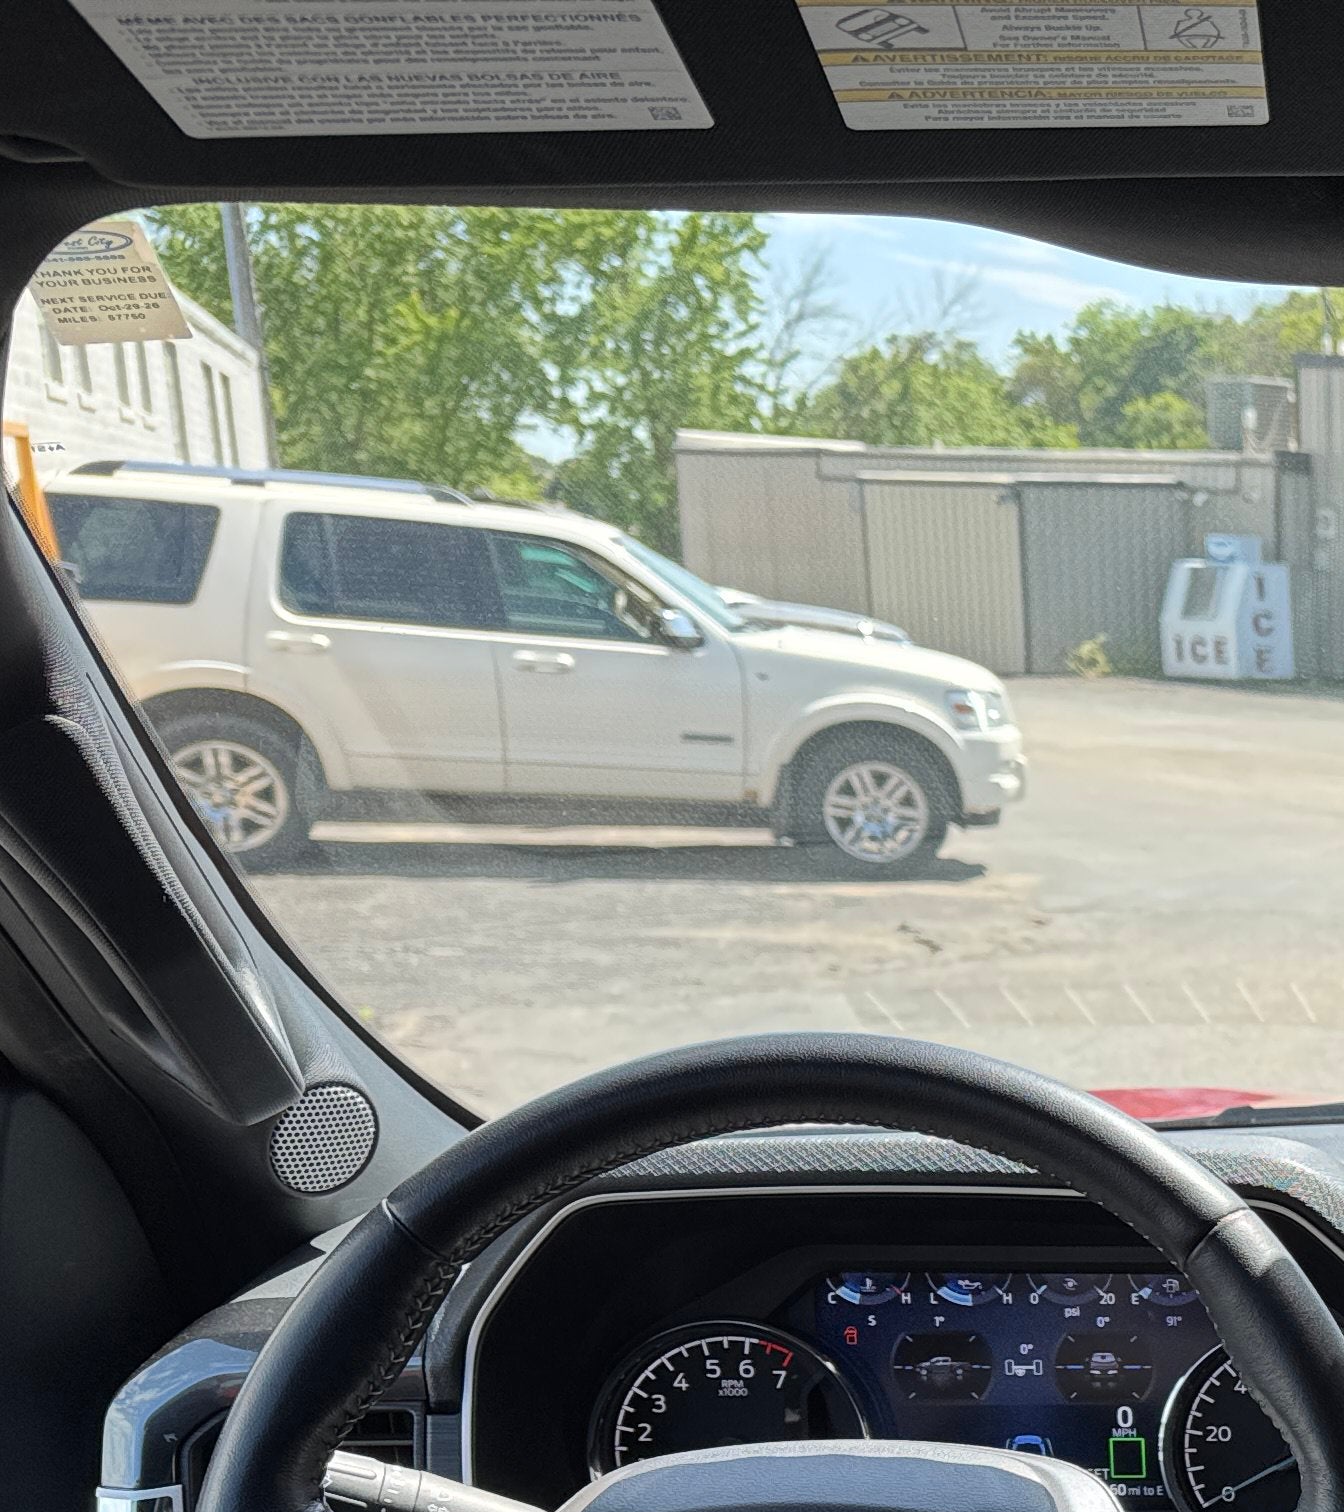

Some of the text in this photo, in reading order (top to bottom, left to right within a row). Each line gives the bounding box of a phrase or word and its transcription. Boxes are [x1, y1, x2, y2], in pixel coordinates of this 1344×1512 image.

[88, 236, 113, 249] City
[86, 267, 118, 275] YOU
[121, 265, 153, 274] FOR
[36, 275, 157, 288] YOUR BUSINESS
[41, 296, 78, 305] NEXT
[78, 293, 137, 304] SERVICE
[1252, 574, 1275, 674] ICE
[1172, 634, 1229, 665] ICE
[901, 1293, 911, 1304] H
[1098, 1293, 1116, 1304] 20
[1131, 1293, 1140, 1304] E
[1064, 1306, 1080, 1318] psi
[705, 1360, 721, 1378] 5
[738, 1359, 755, 1378] 6
[673, 1372, 690, 1391] 4
[721, 1379, 744, 1388] RPM
[772, 1370, 788, 1389] 7
[717, 1387, 748, 1397] x1000
[651, 1394, 668, 1413] 3
[1116, 1406, 1133, 1427] 0
[637, 1423, 653, 1442] 2
[1112, 1428, 1137, 1438] MPH
[1205, 1425, 1232, 1442] 20
[1128, 1485, 1141, 1496] mi
[1142, 1485, 1155, 1496] to
[1156, 1485, 1164, 1496] E
